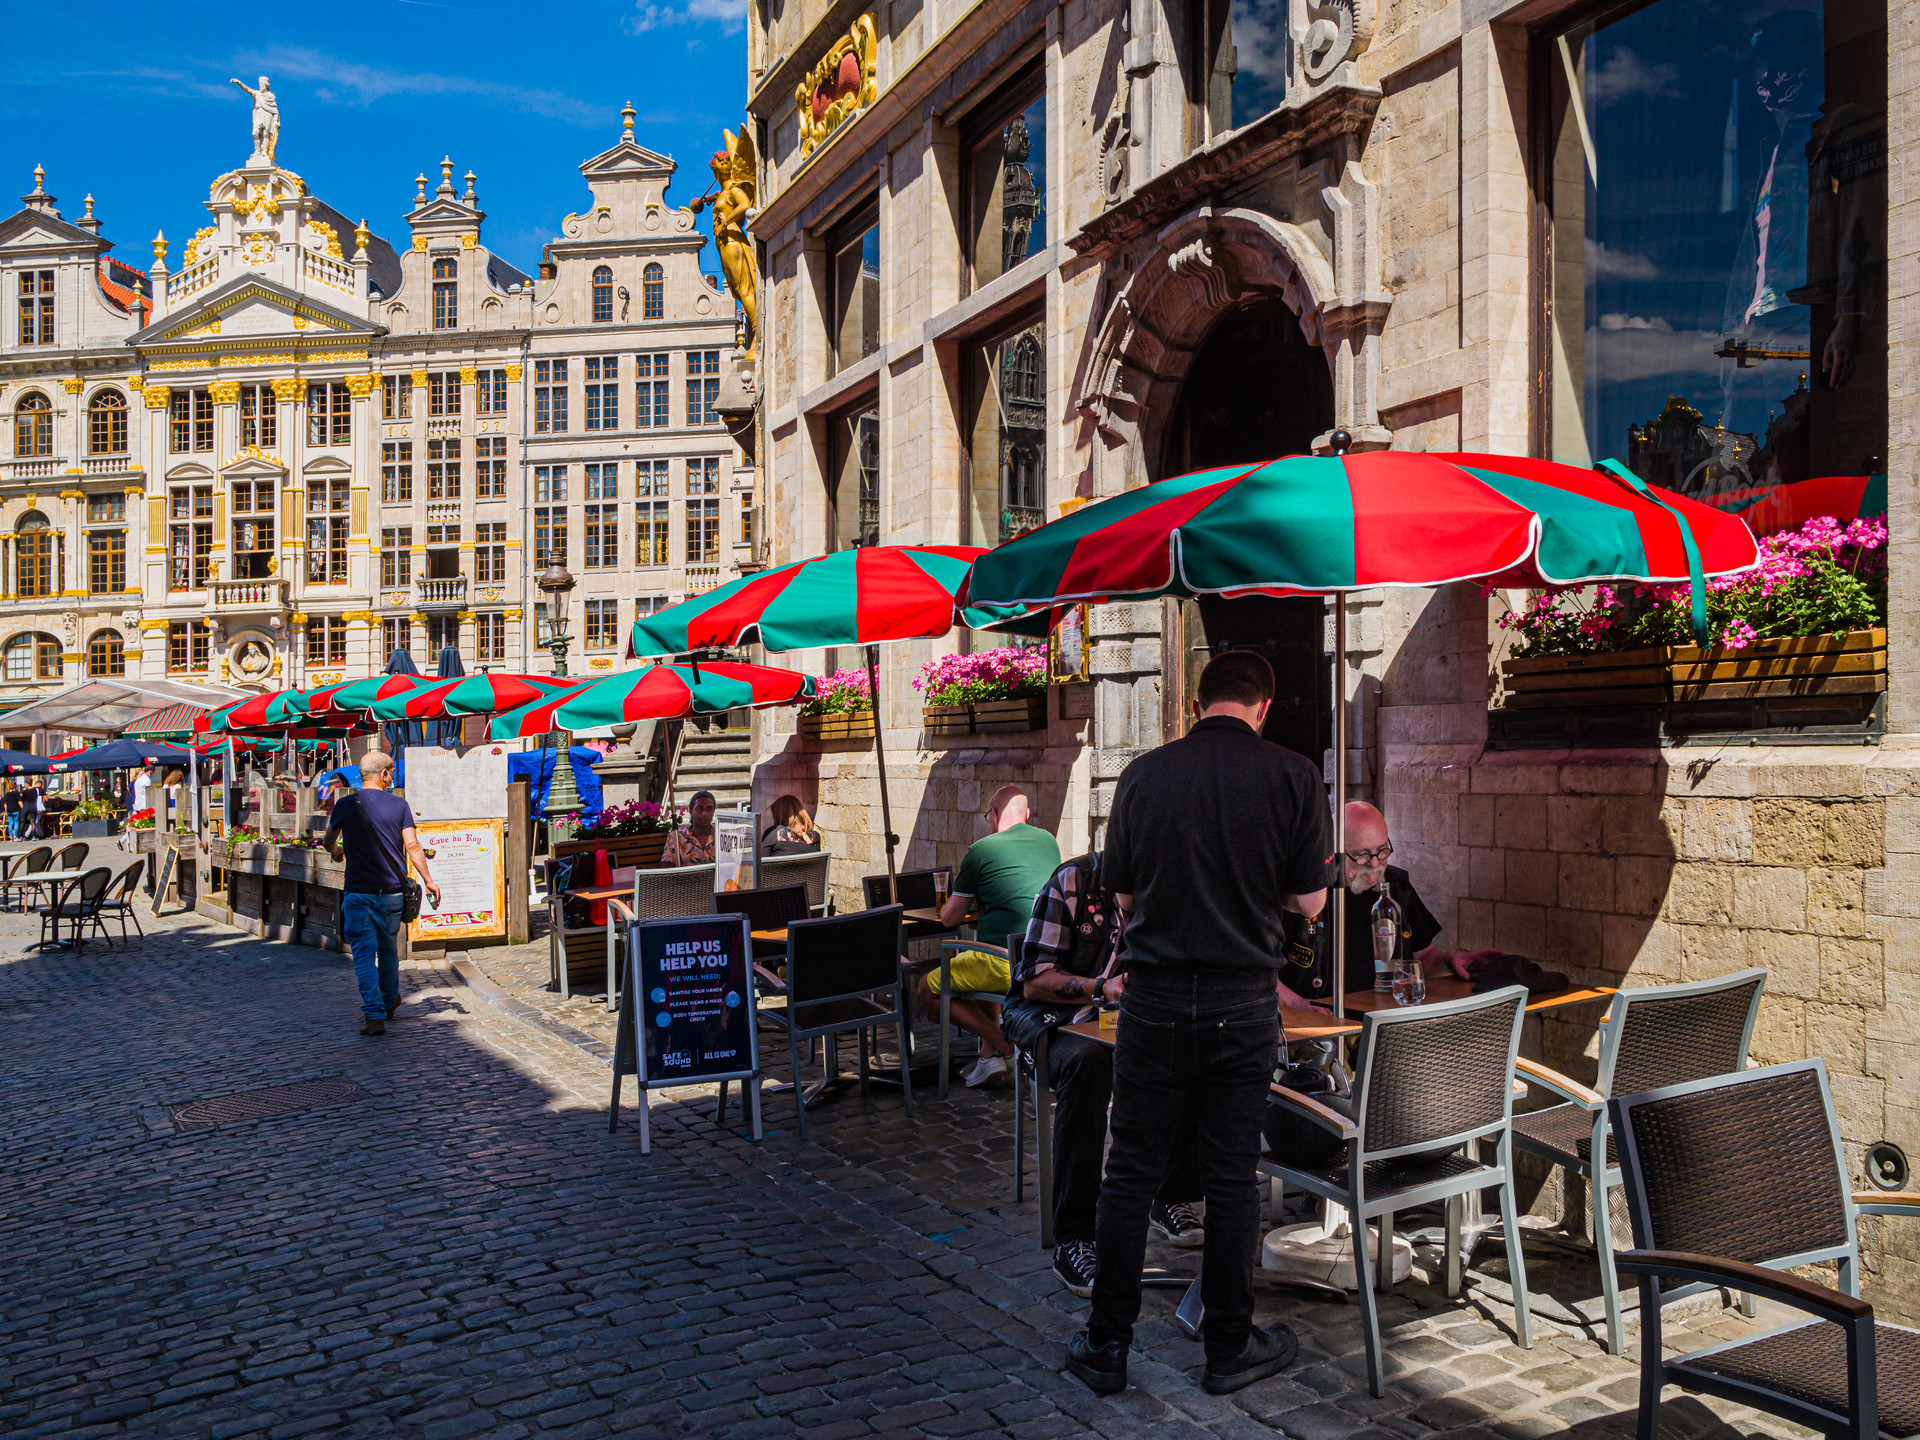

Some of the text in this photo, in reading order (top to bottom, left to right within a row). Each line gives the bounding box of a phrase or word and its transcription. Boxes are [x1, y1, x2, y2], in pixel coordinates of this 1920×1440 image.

[429, 837, 449, 846] Cave
[465, 833, 482, 845] Roy
[1082, 925, 1091, 933] 13
[665, 940, 721, 956] HELP US
[660, 954, 728, 971] HELP YOU
[669, 975, 681, 983] WE
[682, 974, 700, 982] WILL
[688, 1009, 721, 1017] TEMPERATURE
[662, 1052, 682, 1060] SAFE
[704, 1052, 713, 1060] ALL
[713, 1051, 720, 1059] IS
[664, 1058, 691, 1067] SOUND
